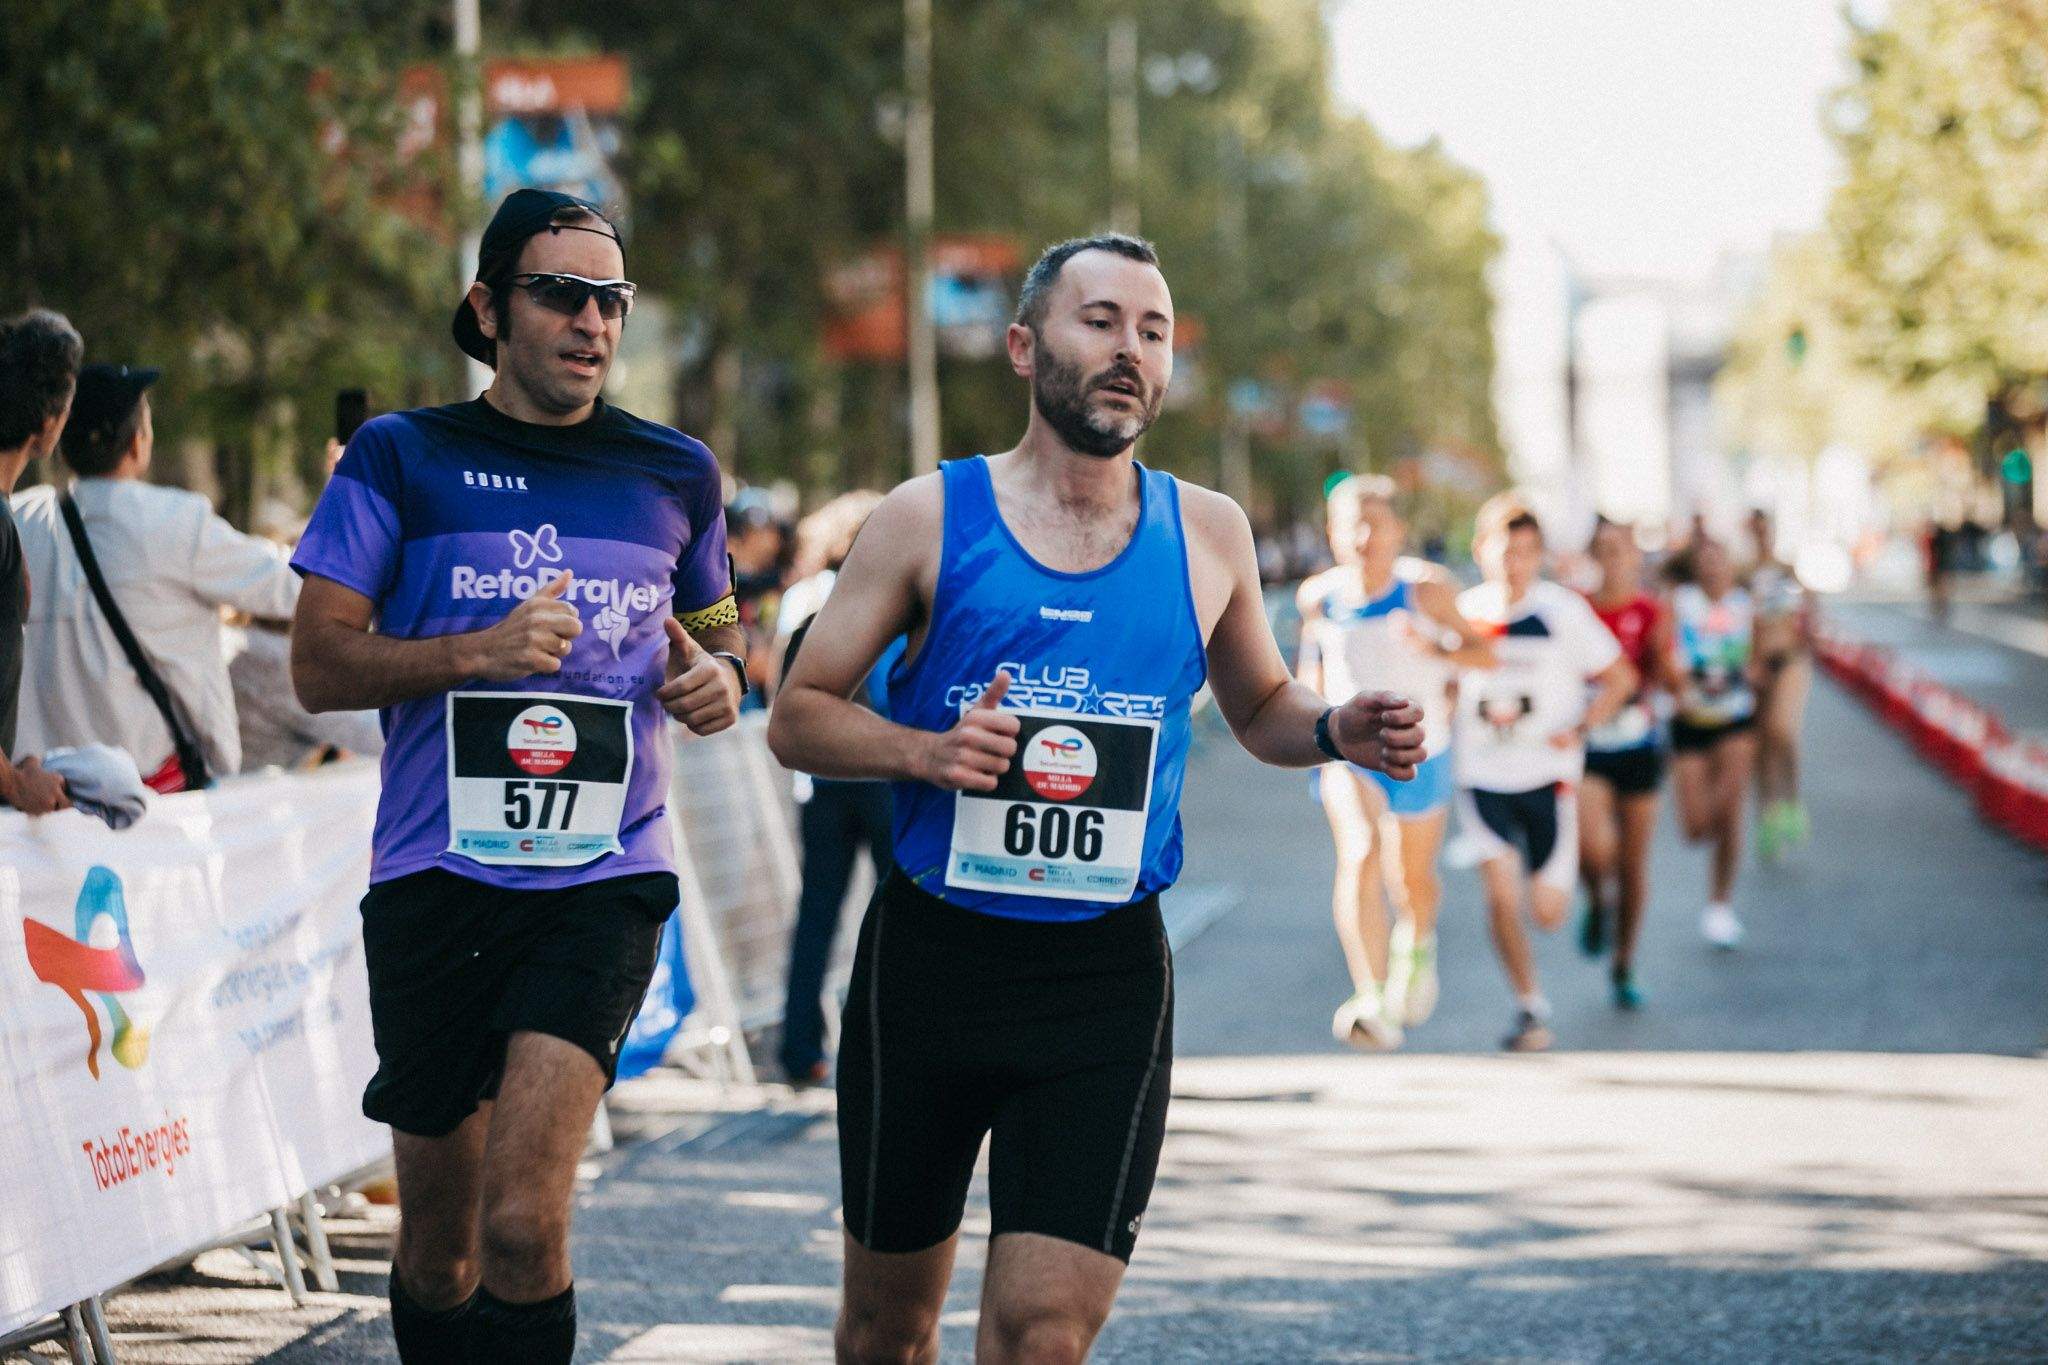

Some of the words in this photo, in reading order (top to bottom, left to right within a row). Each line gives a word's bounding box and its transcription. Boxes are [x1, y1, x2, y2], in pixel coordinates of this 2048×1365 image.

[463, 470, 528, 490] GOBIK
[996, 661, 1089, 690] CLUB
[505, 781, 580, 831] 577
[1004, 803, 1105, 863] 606
[974, 864, 1018, 878] MADRID
[82, 1108, 191, 1193] TotalEnergies
